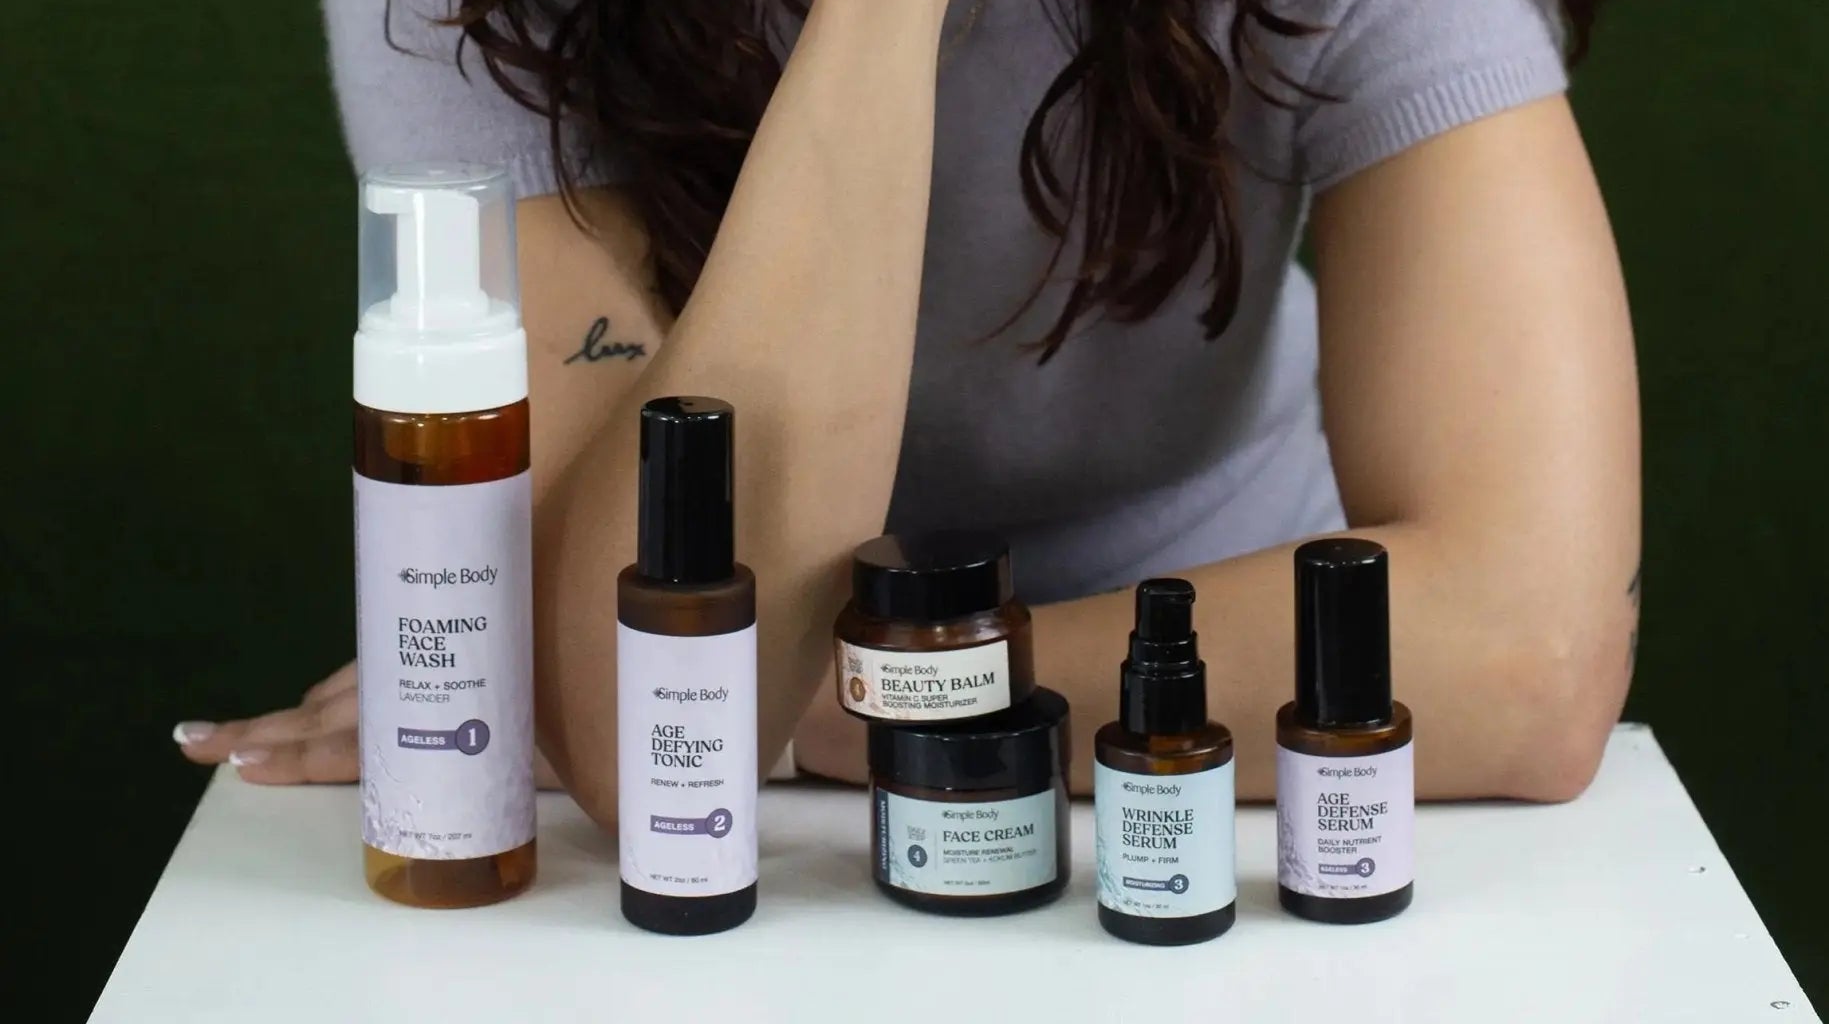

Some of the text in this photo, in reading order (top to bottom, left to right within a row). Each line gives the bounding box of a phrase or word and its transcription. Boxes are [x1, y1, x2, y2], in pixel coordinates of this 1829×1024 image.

[405, 565, 498, 589] Simple Body
[399, 616, 487, 634] FOAMING
[399, 634, 446, 651] FACE
[399, 651, 455, 668] WASH
[885, 664, 939, 677] Simple Body
[400, 678, 431, 690] RELAX
[443, 678, 487, 691] SOOTHE
[881, 678, 946, 693] BEAUTY
[951, 672, 996, 691] BALM
[400, 691, 450, 703] LAVENDER
[658, 686, 729, 704] Simple Body
[882, 694, 911, 702] VITAMIN
[921, 694, 948, 702] SUPER
[882, 697, 978, 709] BOOSTING MOISTURIZER
[400, 727, 477, 746] AGELESS 1
[651, 724, 685, 739] AGE
[652, 738, 723, 753] DEFYING
[651, 752, 703, 768] TONIC
[1321, 766, 1377, 779] Simple Body
[651, 777, 679, 788] RENEW
[688, 779, 724, 788] REFRESH
[1126, 781, 1181, 797] Simple Body
[1317, 792, 1350, 805] AGE
[946, 808, 999, 822] Simple Body
[1122, 807, 1194, 823] WRINKLE
[1318, 801, 1388, 818] DEFENSE
[654, 815, 726, 832] AGELESS 2
[1122, 820, 1193, 836] DEFENSE
[1318, 817, 1374, 831] SERUM
[943, 830, 980, 843] FACE
[984, 824, 1035, 841] CREAM
[1122, 834, 1177, 849] SERUM
[1318, 836, 1382, 846] DAILY NUTRIENT
[913, 850, 920, 862] 4
[943, 846, 1014, 857] MOISTURE RENEWAL
[1318, 846, 1357, 854] BOOSTER
[1122, 853, 1149, 863] PLUMP
[1158, 856, 1179, 864] FIRM
[1361, 862, 1370, 873] 3
[1174, 879, 1183, 890] 3
